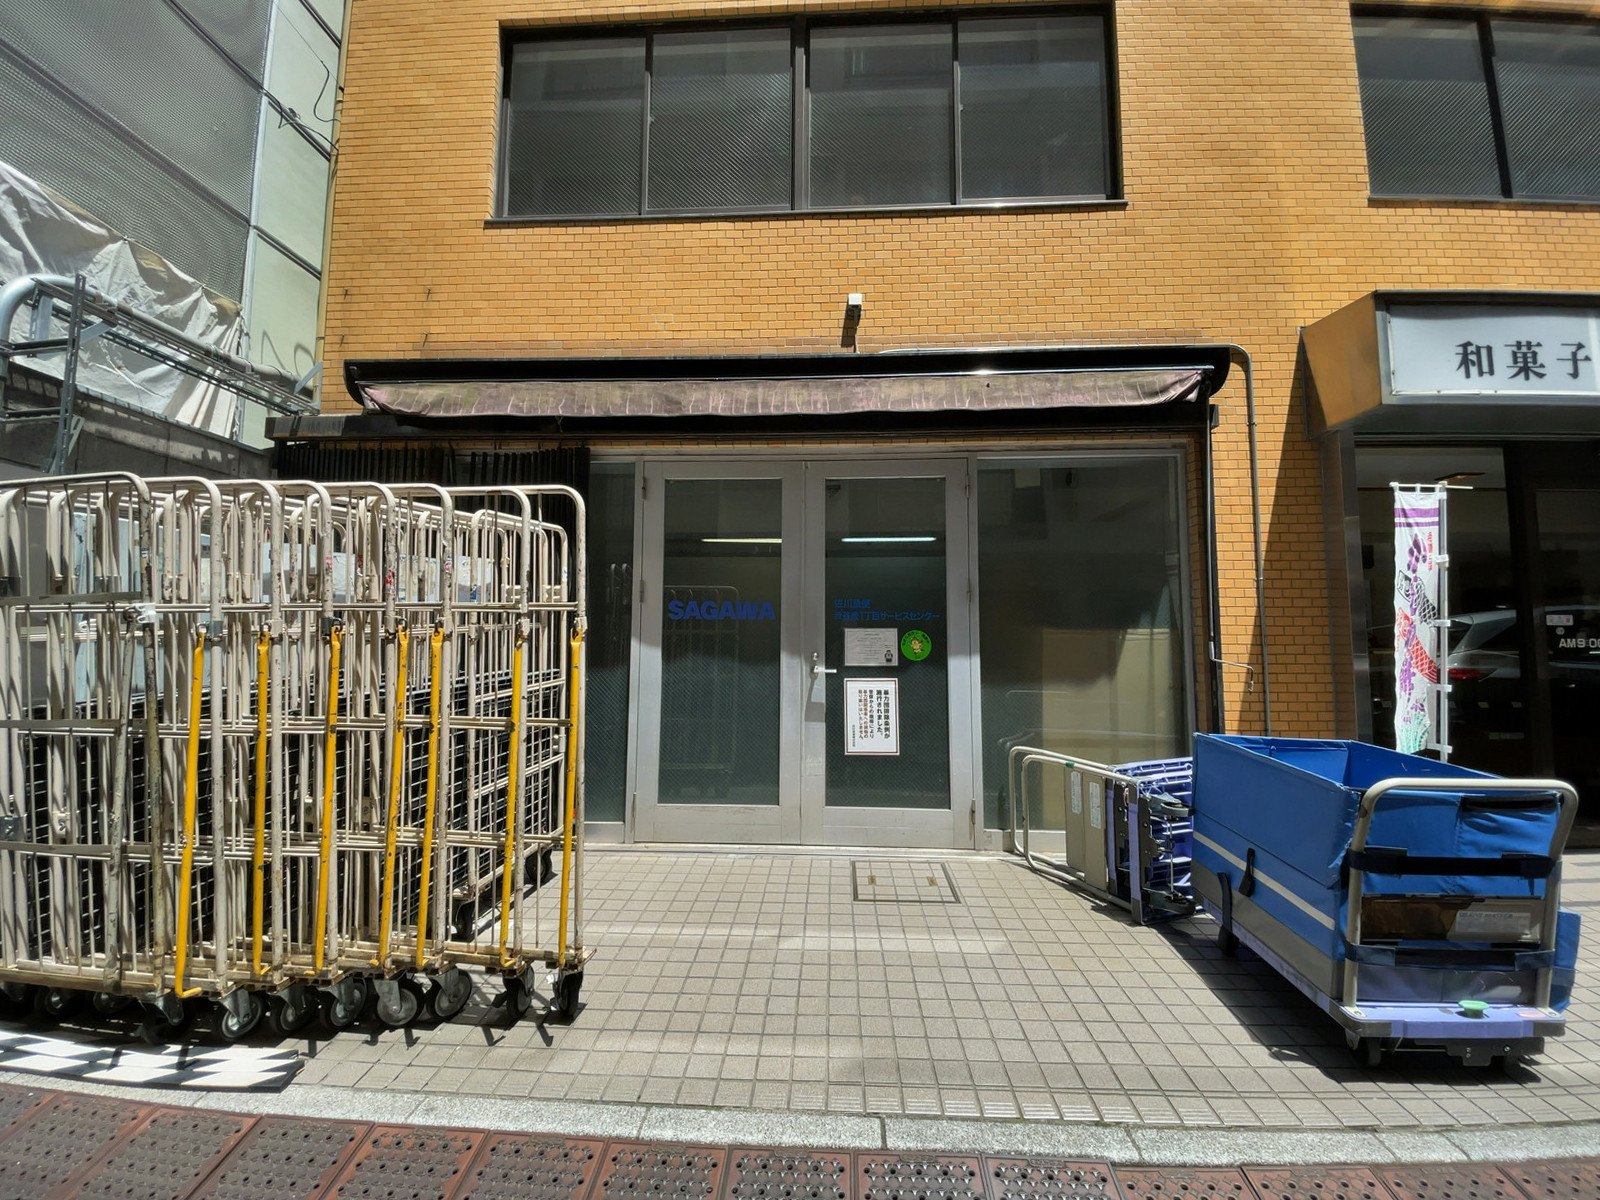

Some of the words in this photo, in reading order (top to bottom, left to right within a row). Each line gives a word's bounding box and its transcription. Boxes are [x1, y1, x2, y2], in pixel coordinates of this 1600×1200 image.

[1455, 340, 1592, 381] 和菓子
[668, 600, 776, 620] SAGAWA
